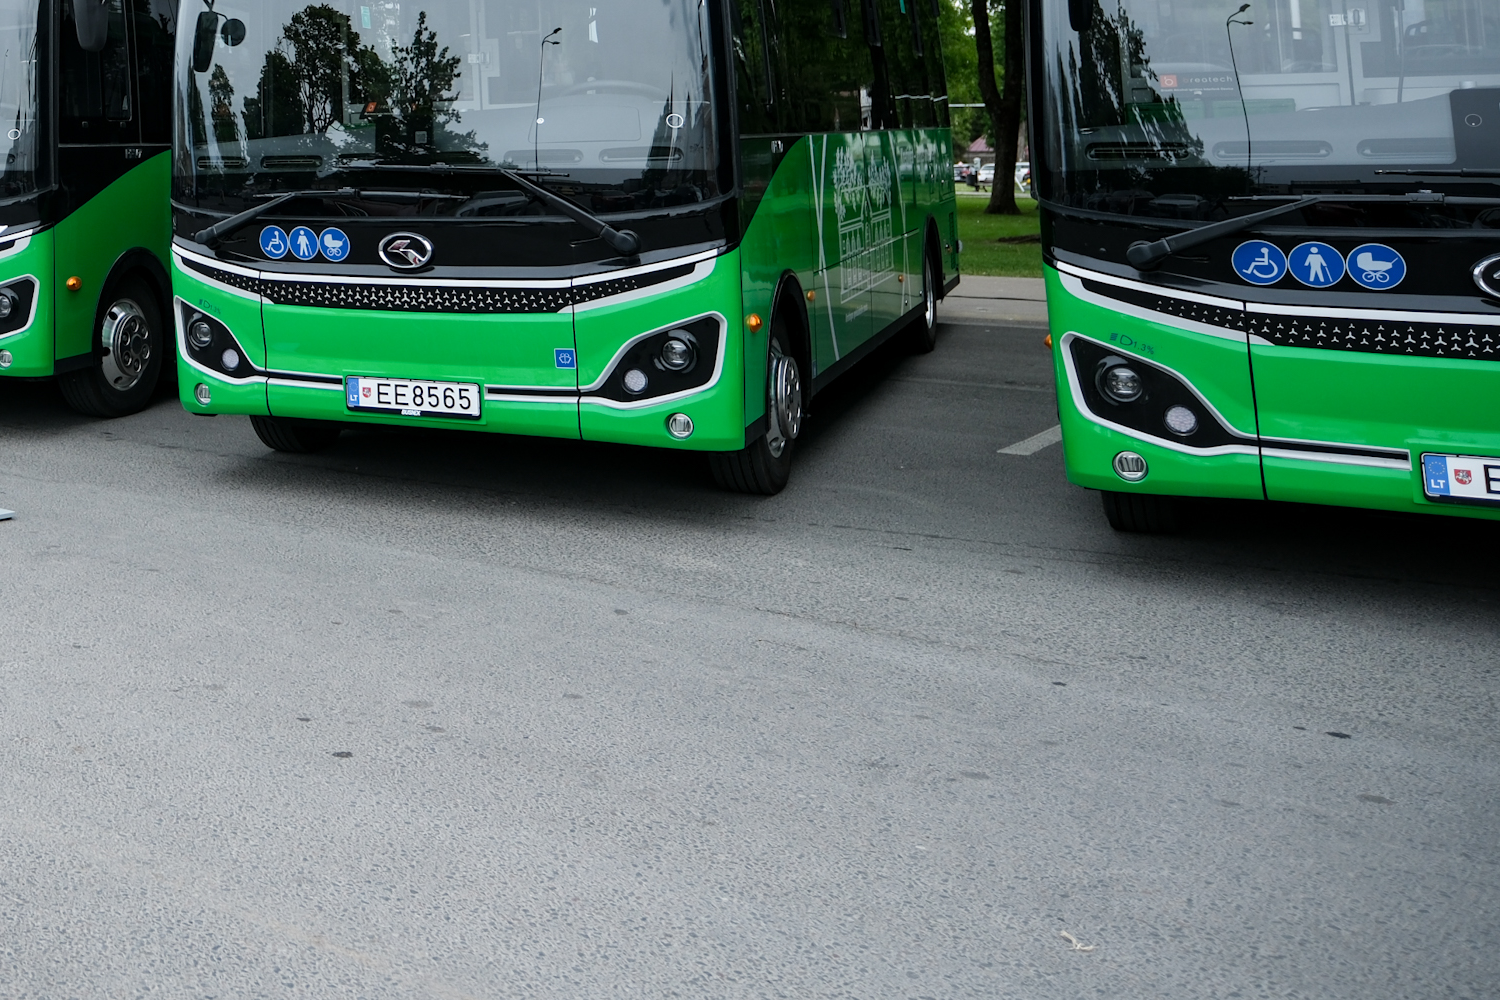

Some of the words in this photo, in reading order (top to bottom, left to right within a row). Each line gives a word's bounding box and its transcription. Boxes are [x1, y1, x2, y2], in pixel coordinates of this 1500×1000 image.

[1133, 341, 1155, 355] 1.3%
[350, 394, 359, 402] LT
[377, 383, 471, 410] EE8565
[1431, 479, 1446, 489] LT
